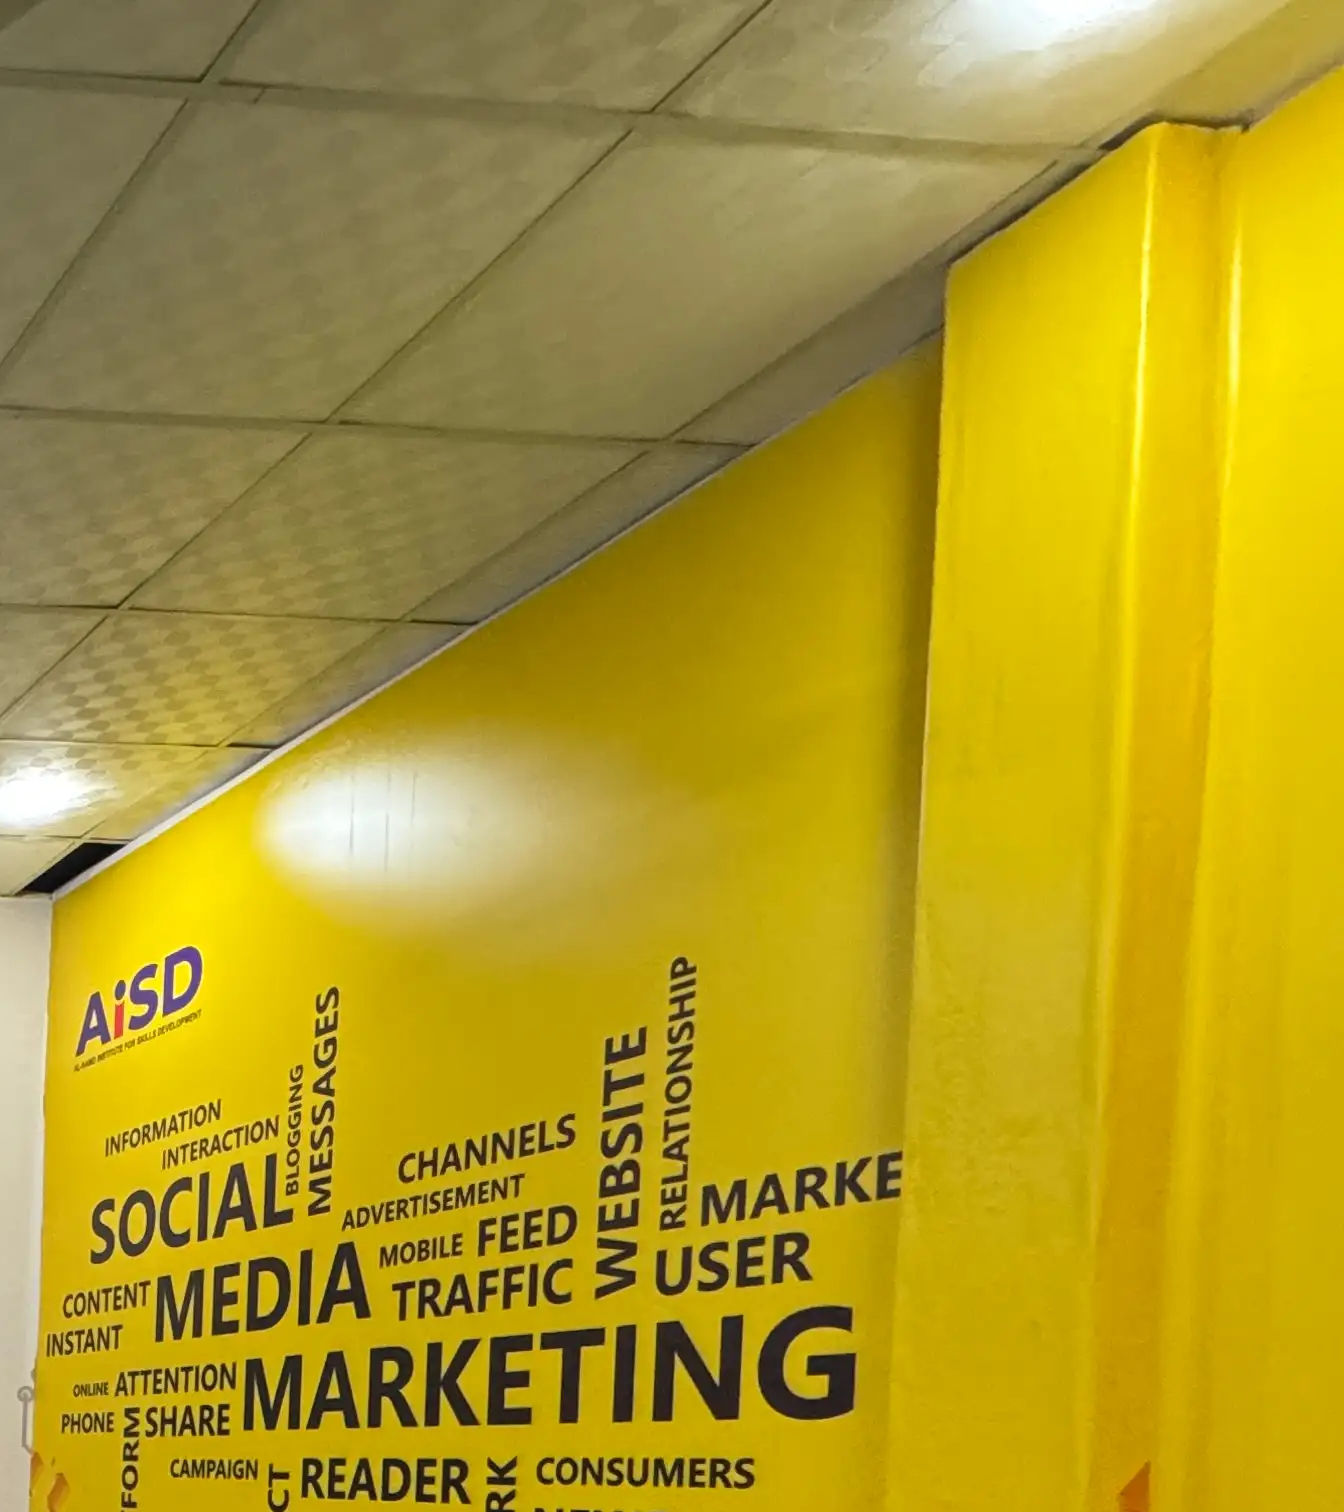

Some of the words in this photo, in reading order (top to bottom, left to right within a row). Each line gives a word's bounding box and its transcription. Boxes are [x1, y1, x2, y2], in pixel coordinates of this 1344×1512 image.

[75, 946, 202, 1057] AiSD
[307, 986, 340, 1216] MESSAGES
[659, 957, 698, 1231] RELATIONSHIP
[104, 1098, 222, 1157] INFORMATION
[162, 1114, 280, 1170] INTERACTION
[285, 1063, 304, 1196] BLOGGING
[398, 1113, 577, 1184] CHANNELS
[594, 1026, 648, 1299] WEBSITE
[700, 1151, 903, 1226] MARKE
[89, 1152, 294, 1265] SOCIAL
[341, 1173, 525, 1232] ADVERTISEMENT
[477, 1205, 578, 1257] FEED
[378, 1233, 464, 1268] MOBILE
[655, 1232, 813, 1296] USER
[62, 1280, 151, 1318] CONTENT
[154, 1241, 372, 1343] MEDIA
[391, 1258, 574, 1322] TRAFFIC
[46, 1325, 123, 1357] INSTANT
[242, 1305, 857, 1431] MARKETING
[72, 1380, 109, 1398] ONLINE
[114, 1362, 237, 1398] ATTENTION
[60, 1411, 115, 1435] PHONE
[144, 1403, 231, 1438] SHARE
[170, 1459, 259, 1480] CAMPAIGN
[301, 1457, 472, 1505] READER
[536, 1457, 756, 1489] CONSUMERS
